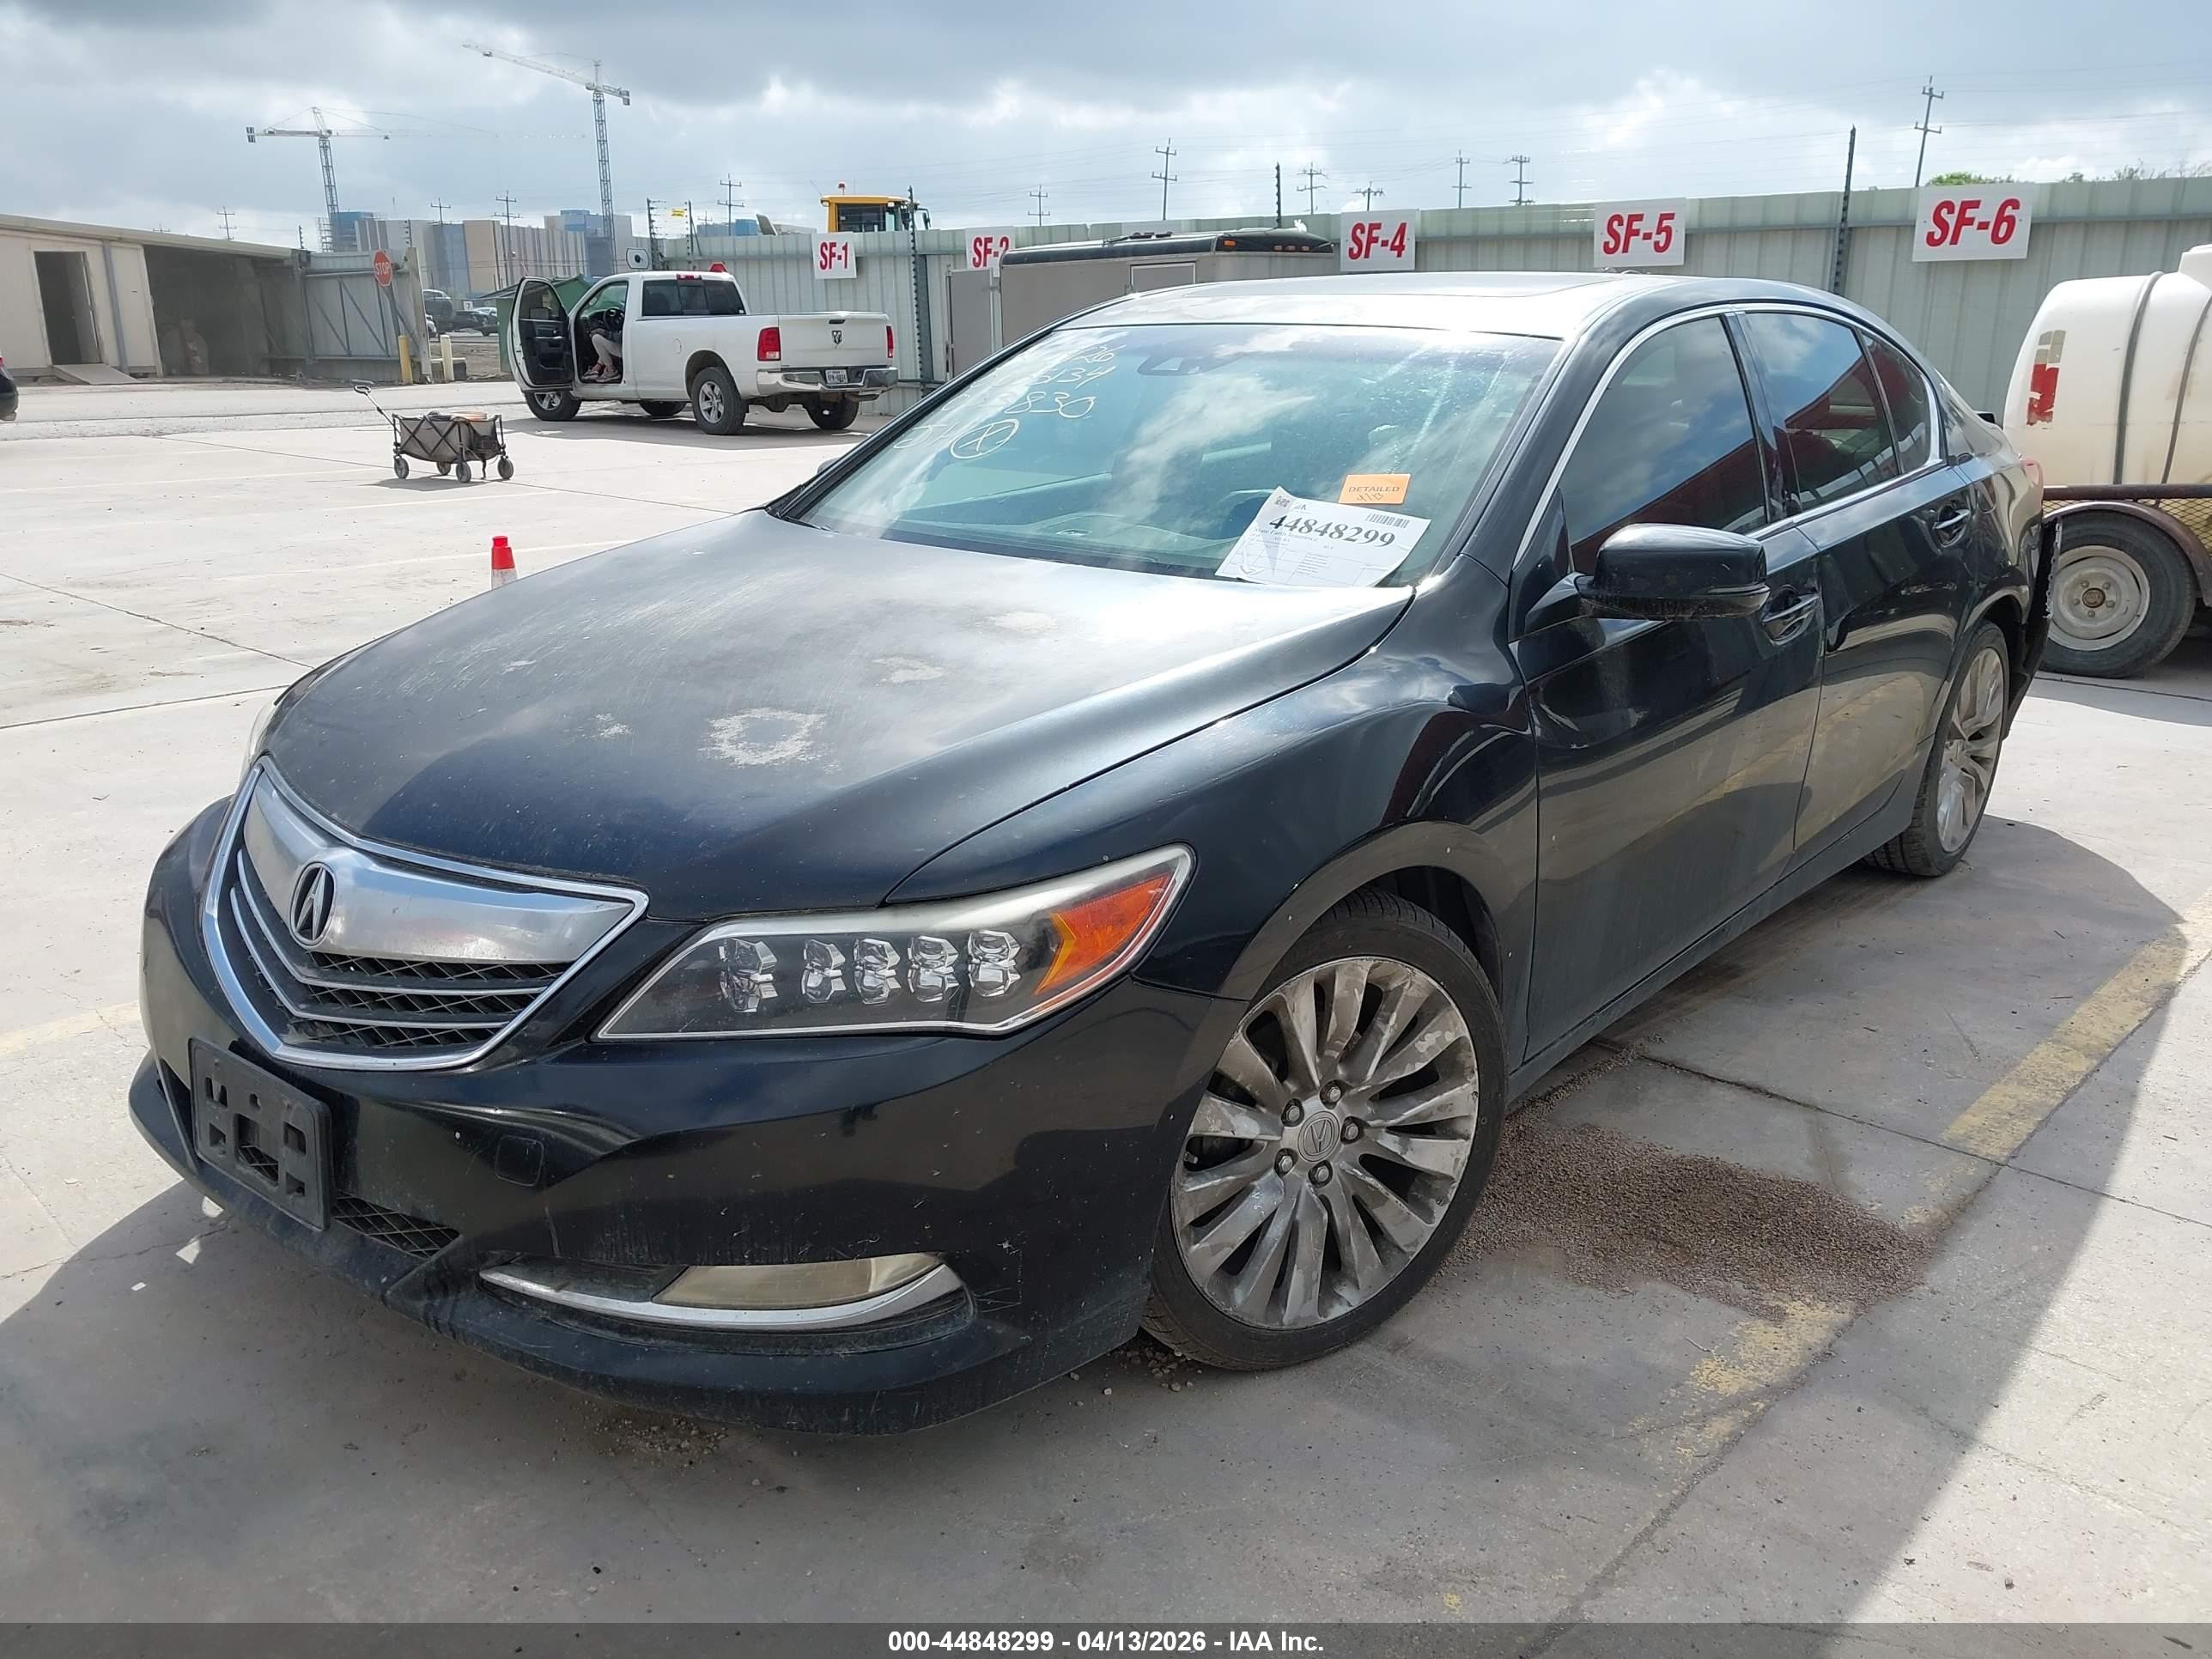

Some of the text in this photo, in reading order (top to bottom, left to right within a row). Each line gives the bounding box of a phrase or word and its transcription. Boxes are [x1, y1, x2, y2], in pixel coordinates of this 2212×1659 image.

[1347, 222, 1407, 260] SF-4
[1602, 213, 1674, 255] SF-5
[1925, 199, 2020, 247] SF-6
[374, 262, 391, 276] STOP
[818, 240, 850, 270] SF-1
[1268, 514, 1396, 548] 44848299
